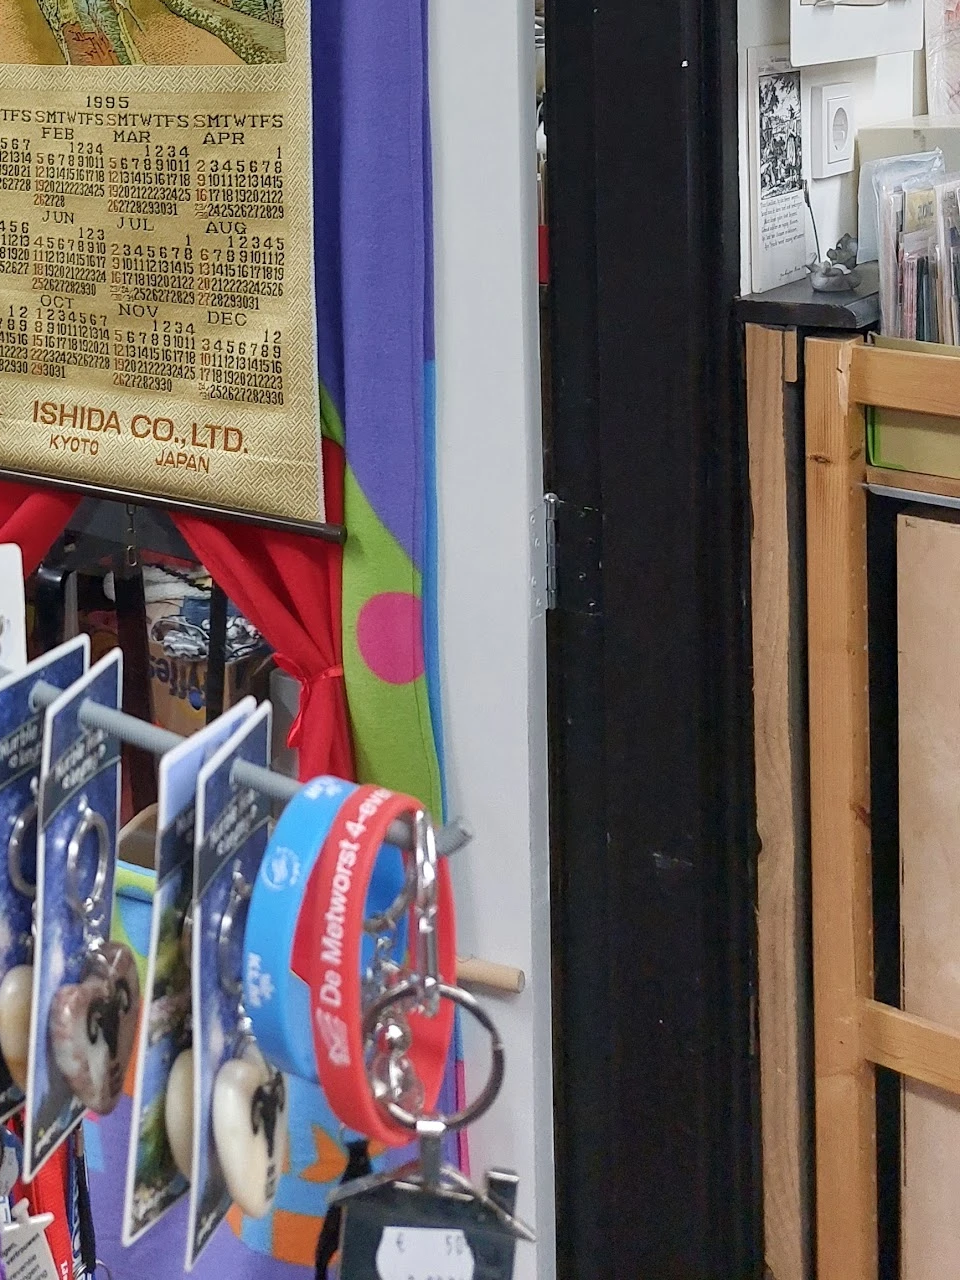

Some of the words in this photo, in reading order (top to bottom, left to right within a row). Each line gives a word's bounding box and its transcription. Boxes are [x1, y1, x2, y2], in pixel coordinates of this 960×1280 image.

[86, 95, 129, 109] 1995
[41, 126, 75, 140] FEB
[113, 130, 152, 144] MAR
[202, 131, 245, 145] APR
[41, 210, 74, 225] JUN
[117, 216, 155, 232] JUL
[205, 221, 247, 235] AUG
[40, 294, 75, 309] OCT
[118, 303, 159, 318] NOV
[207, 311, 247, 326] DEC
[33, 399, 121, 435] ISHIDA
[49, 434, 99, 456] KYOTO
[155, 449, 211, 474] JAPAN
[321, 838, 361, 966] Metworst
[320, 969, 342, 1007] De
